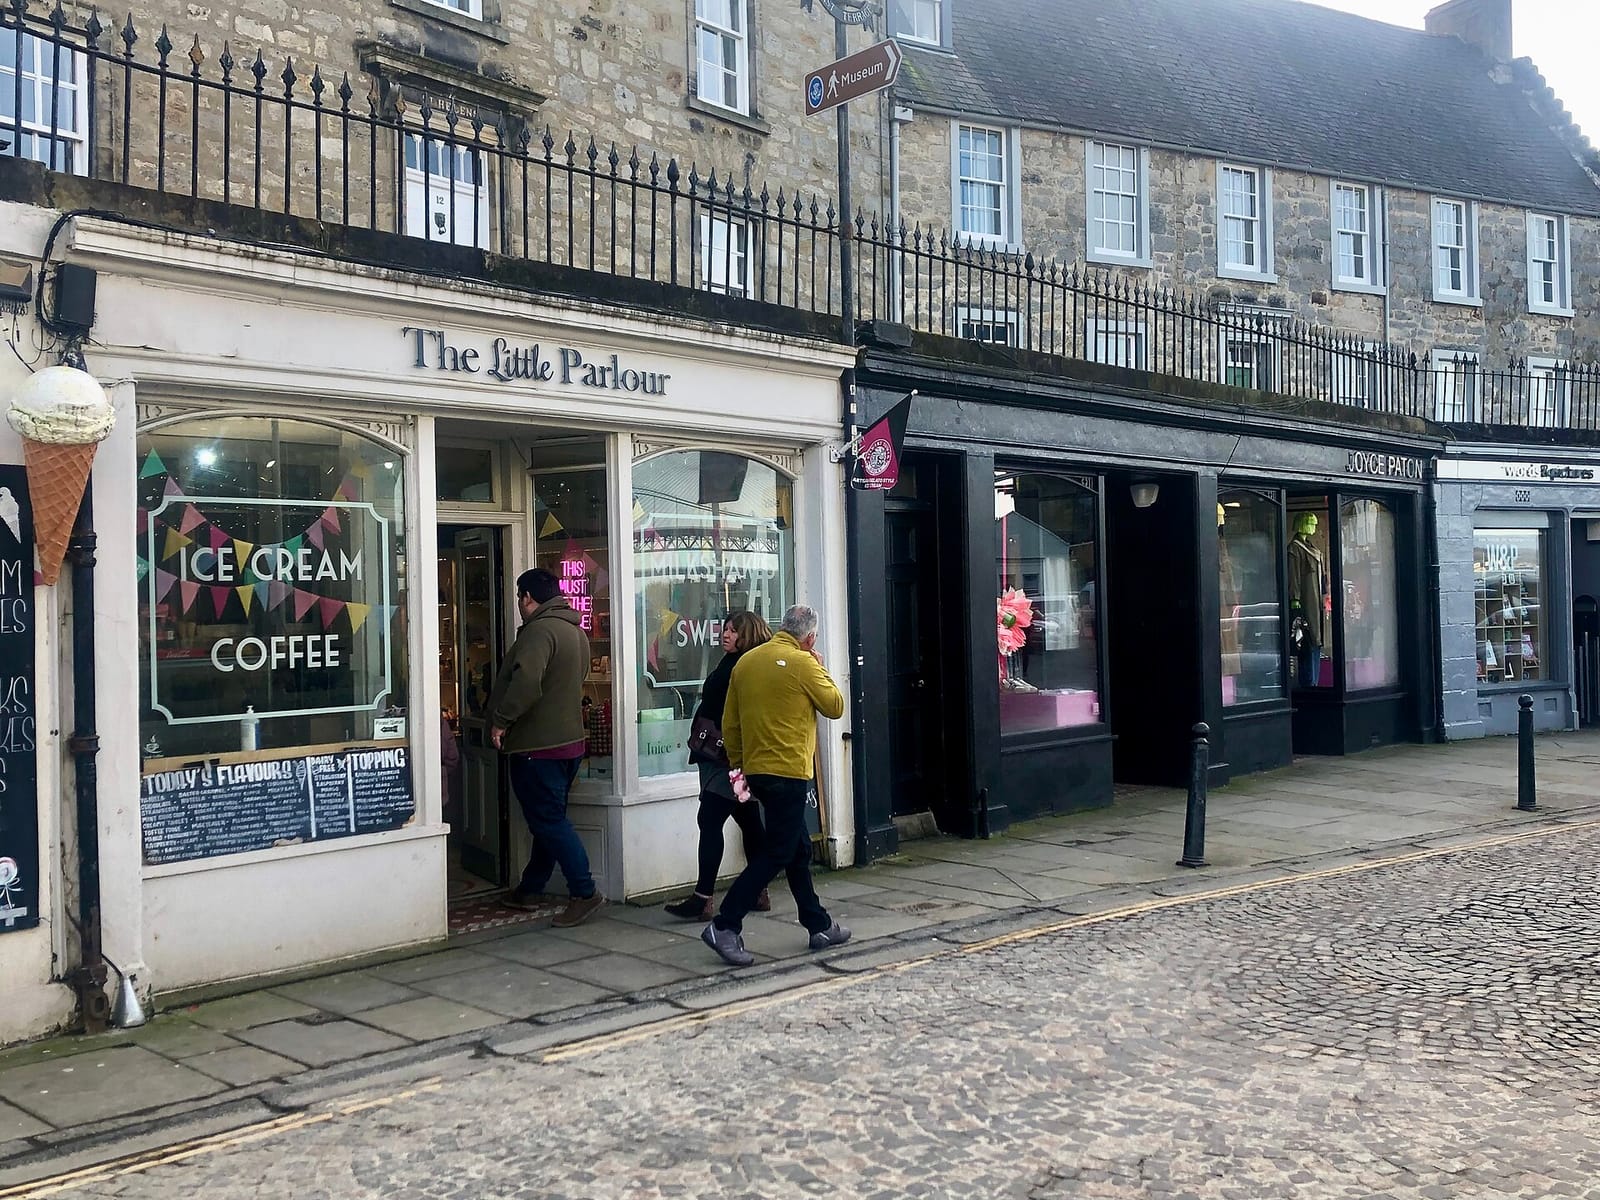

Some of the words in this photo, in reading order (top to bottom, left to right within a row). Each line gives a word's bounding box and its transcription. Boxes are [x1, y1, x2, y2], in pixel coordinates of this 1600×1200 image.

[841, 61, 883, 87] Museum
[436, 195, 444, 205] 12
[402, 326, 481, 373] The
[487, 337, 554, 382] Little
[559, 347, 672, 395] Parlour
[1346, 451, 1385, 475] JOYCE
[1387, 455, 1423, 479] PATON
[180, 548, 234, 582] ICE
[251, 548, 362, 582] CREAM
[560, 561, 583, 577] THIS
[571, 596, 591, 612] THE
[676, 618, 725, 648] SWE
[210, 634, 340, 673] COFFEE
[311, 755, 334, 765] DAIRY
[647, 741, 672, 756] Juice
[143, 768, 213, 795] TODAY'S
[216, 760, 293, 786] FLAVOURS
[319, 764, 335, 772] FREE
